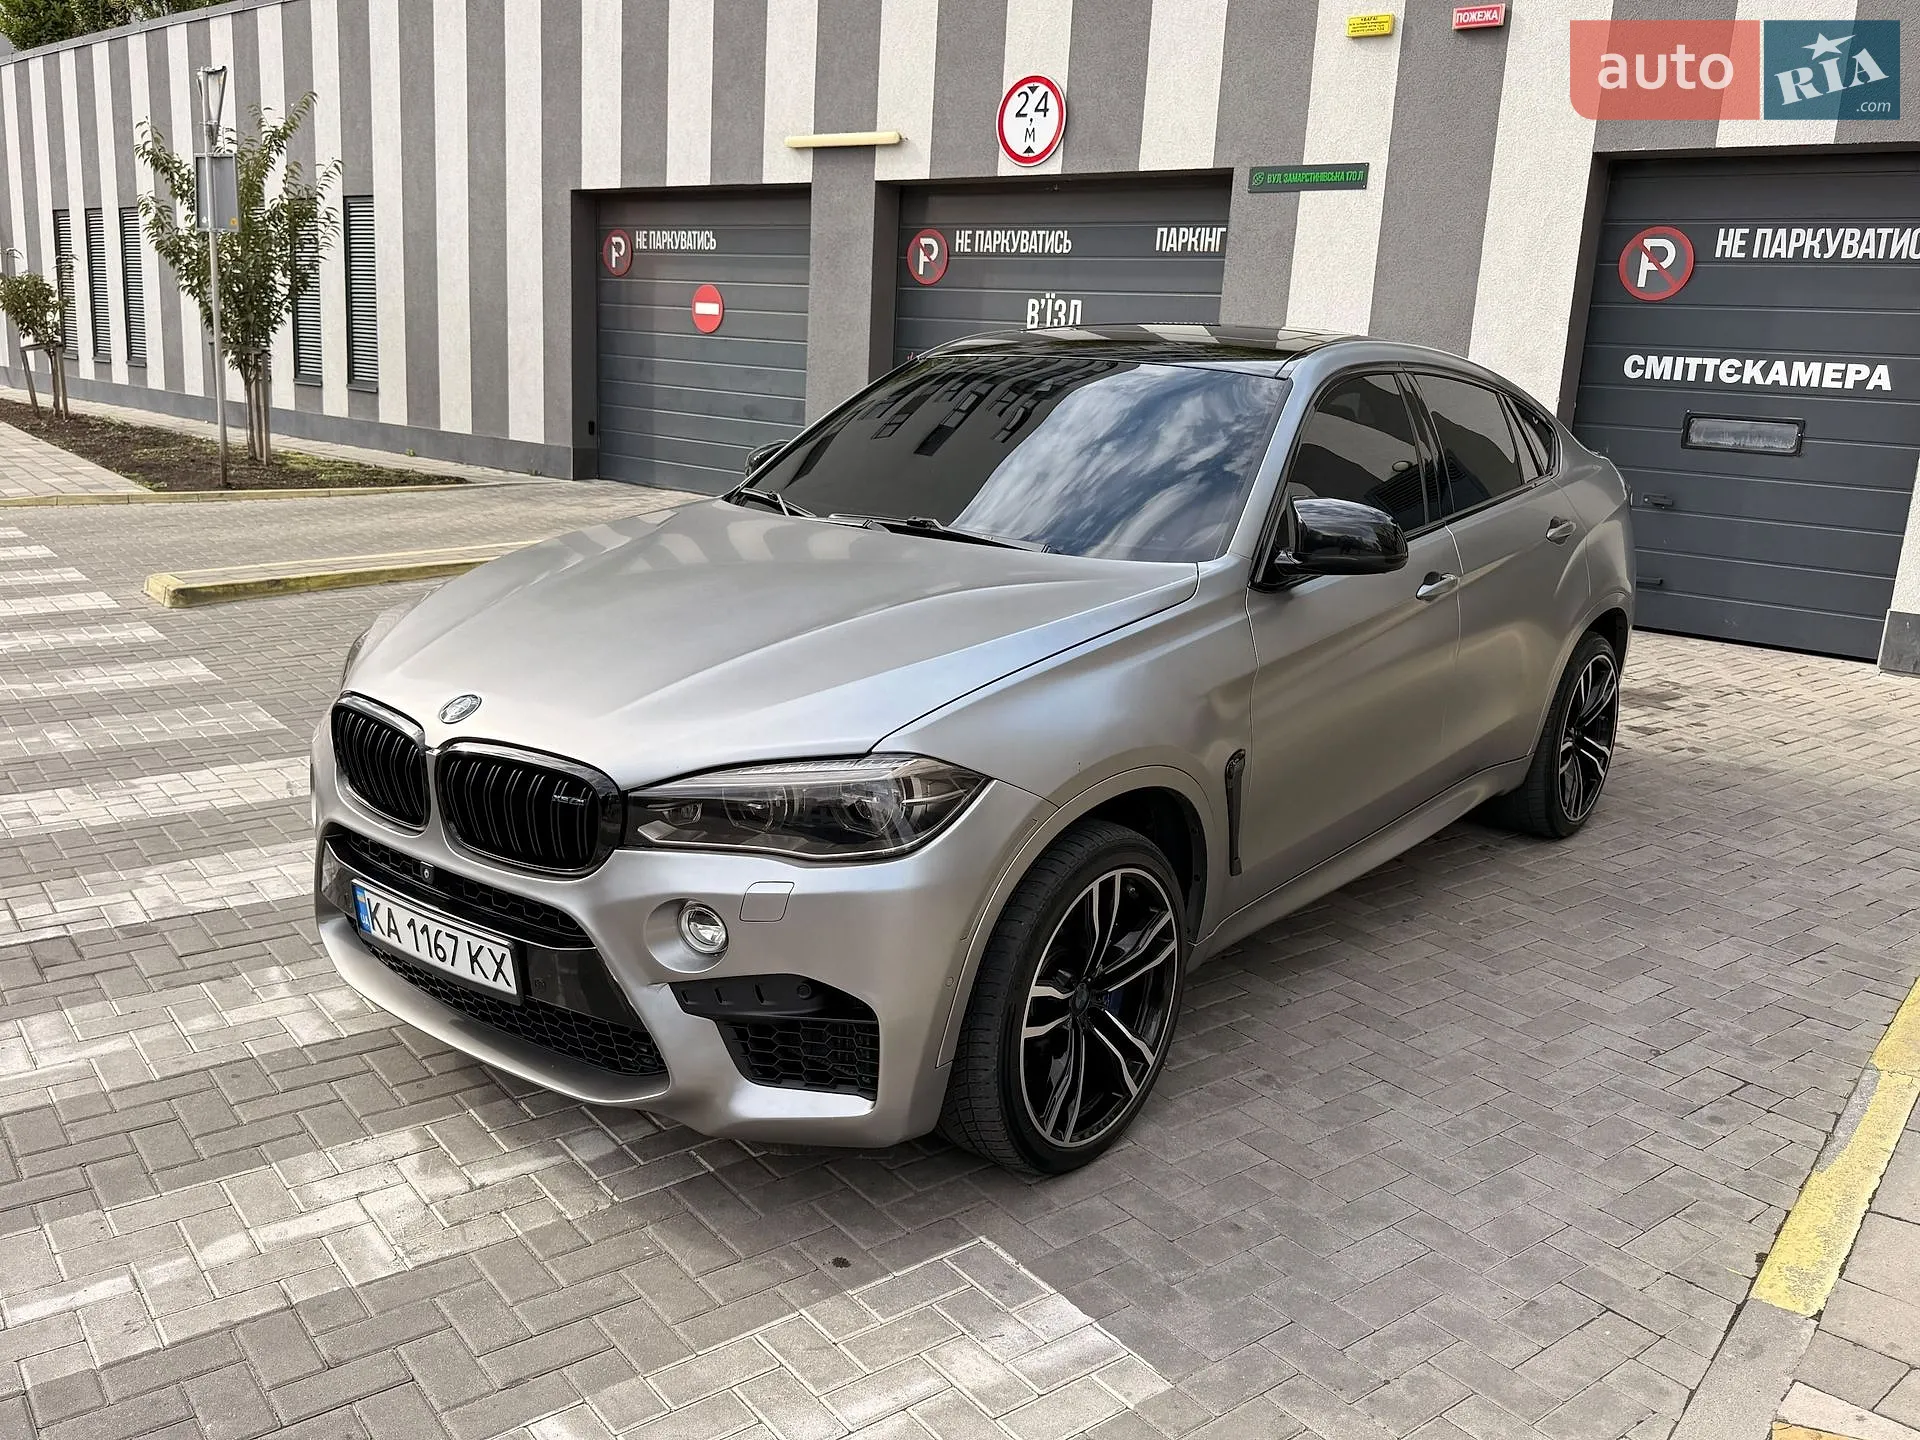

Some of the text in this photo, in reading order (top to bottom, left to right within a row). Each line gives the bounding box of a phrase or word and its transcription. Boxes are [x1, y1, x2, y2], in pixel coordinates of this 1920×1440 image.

[1455, 12, 1499, 25] ПОЖЕЖА
[636, 230, 717, 251] НЕ ПАРКУВАТИСЬ
[955, 230, 1072, 254] НЕ ПАРКУВАТИСЬ
[1155, 227, 1227, 253] ПАРКІНГ
[1714, 228, 1750, 259] НЕ
[1623, 354, 1892, 392] СМІТТЄКАМЕРА
[366, 898, 512, 988] KA 1167 KX
